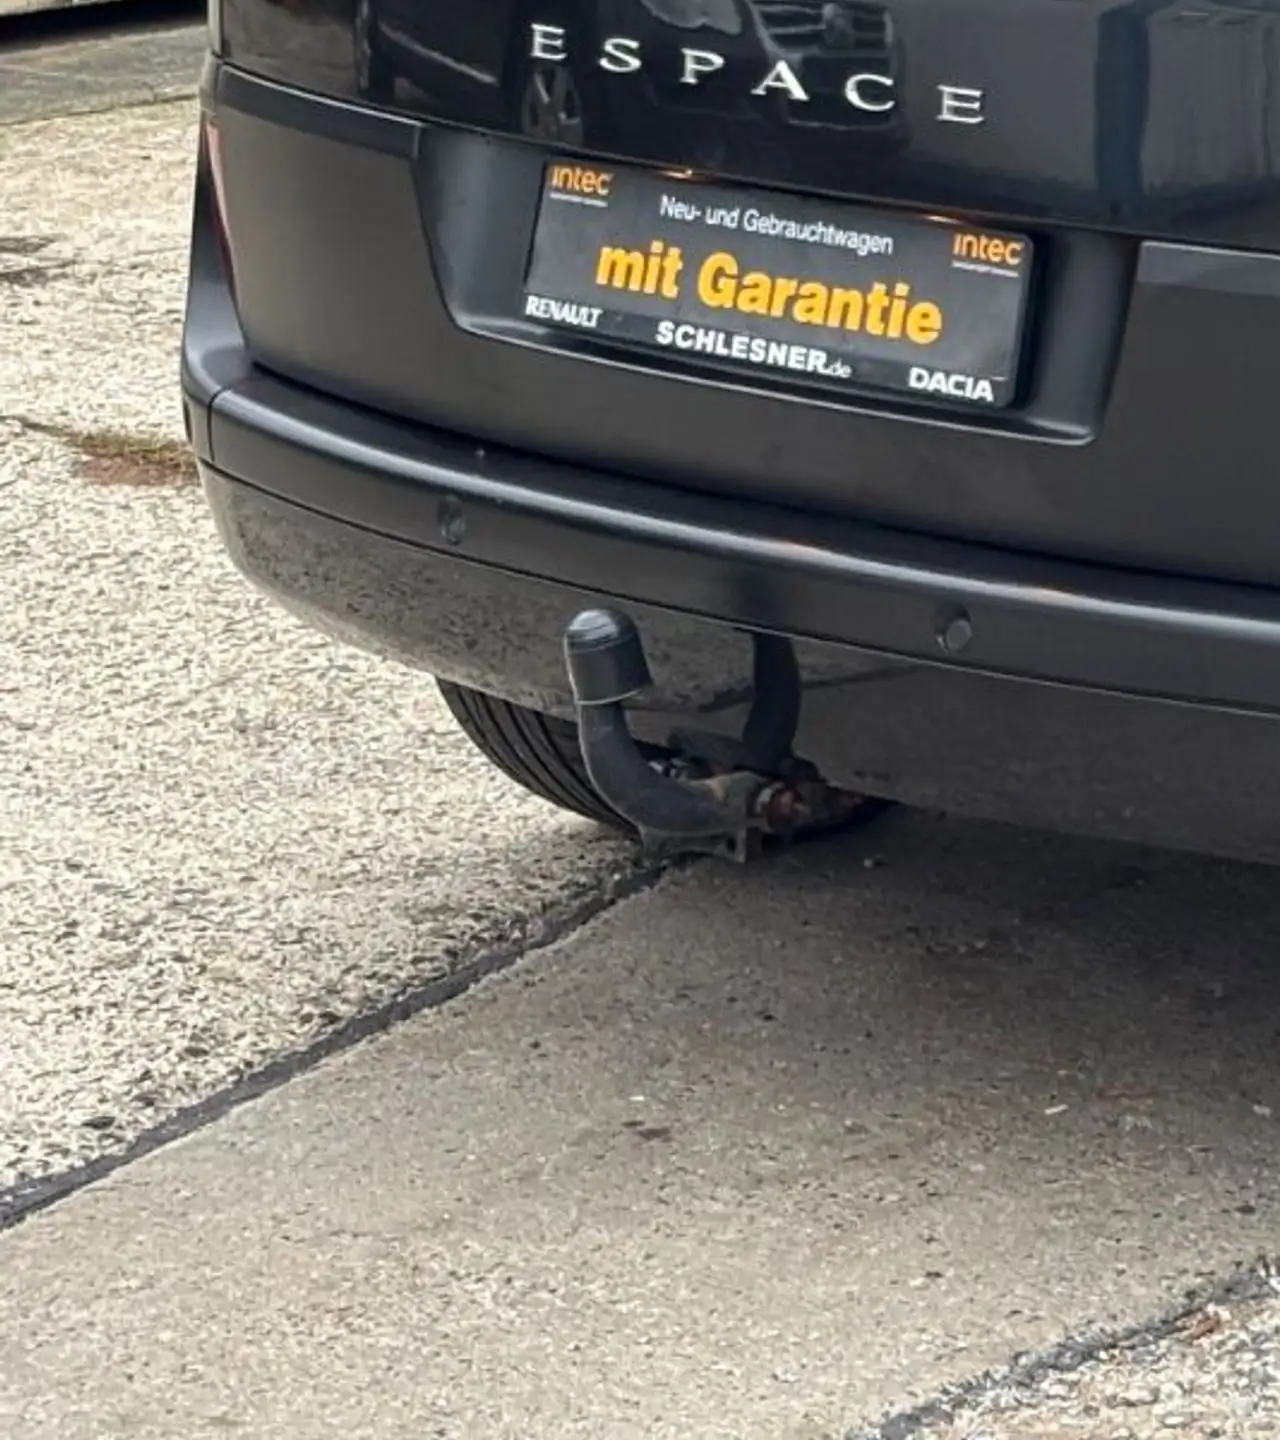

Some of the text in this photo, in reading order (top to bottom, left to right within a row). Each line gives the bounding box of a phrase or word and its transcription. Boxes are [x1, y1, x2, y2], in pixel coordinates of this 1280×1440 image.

[530, 23, 985, 124] ESPACE
[551, 164, 615, 197] intec
[660, 194, 894, 257] Neu- und Gebrauchtwagen
[952, 232, 1025, 266] intec
[596, 240, 943, 345] mit Garantie
[525, 295, 603, 328] RENAULT
[909, 367, 995, 402] DACIA
